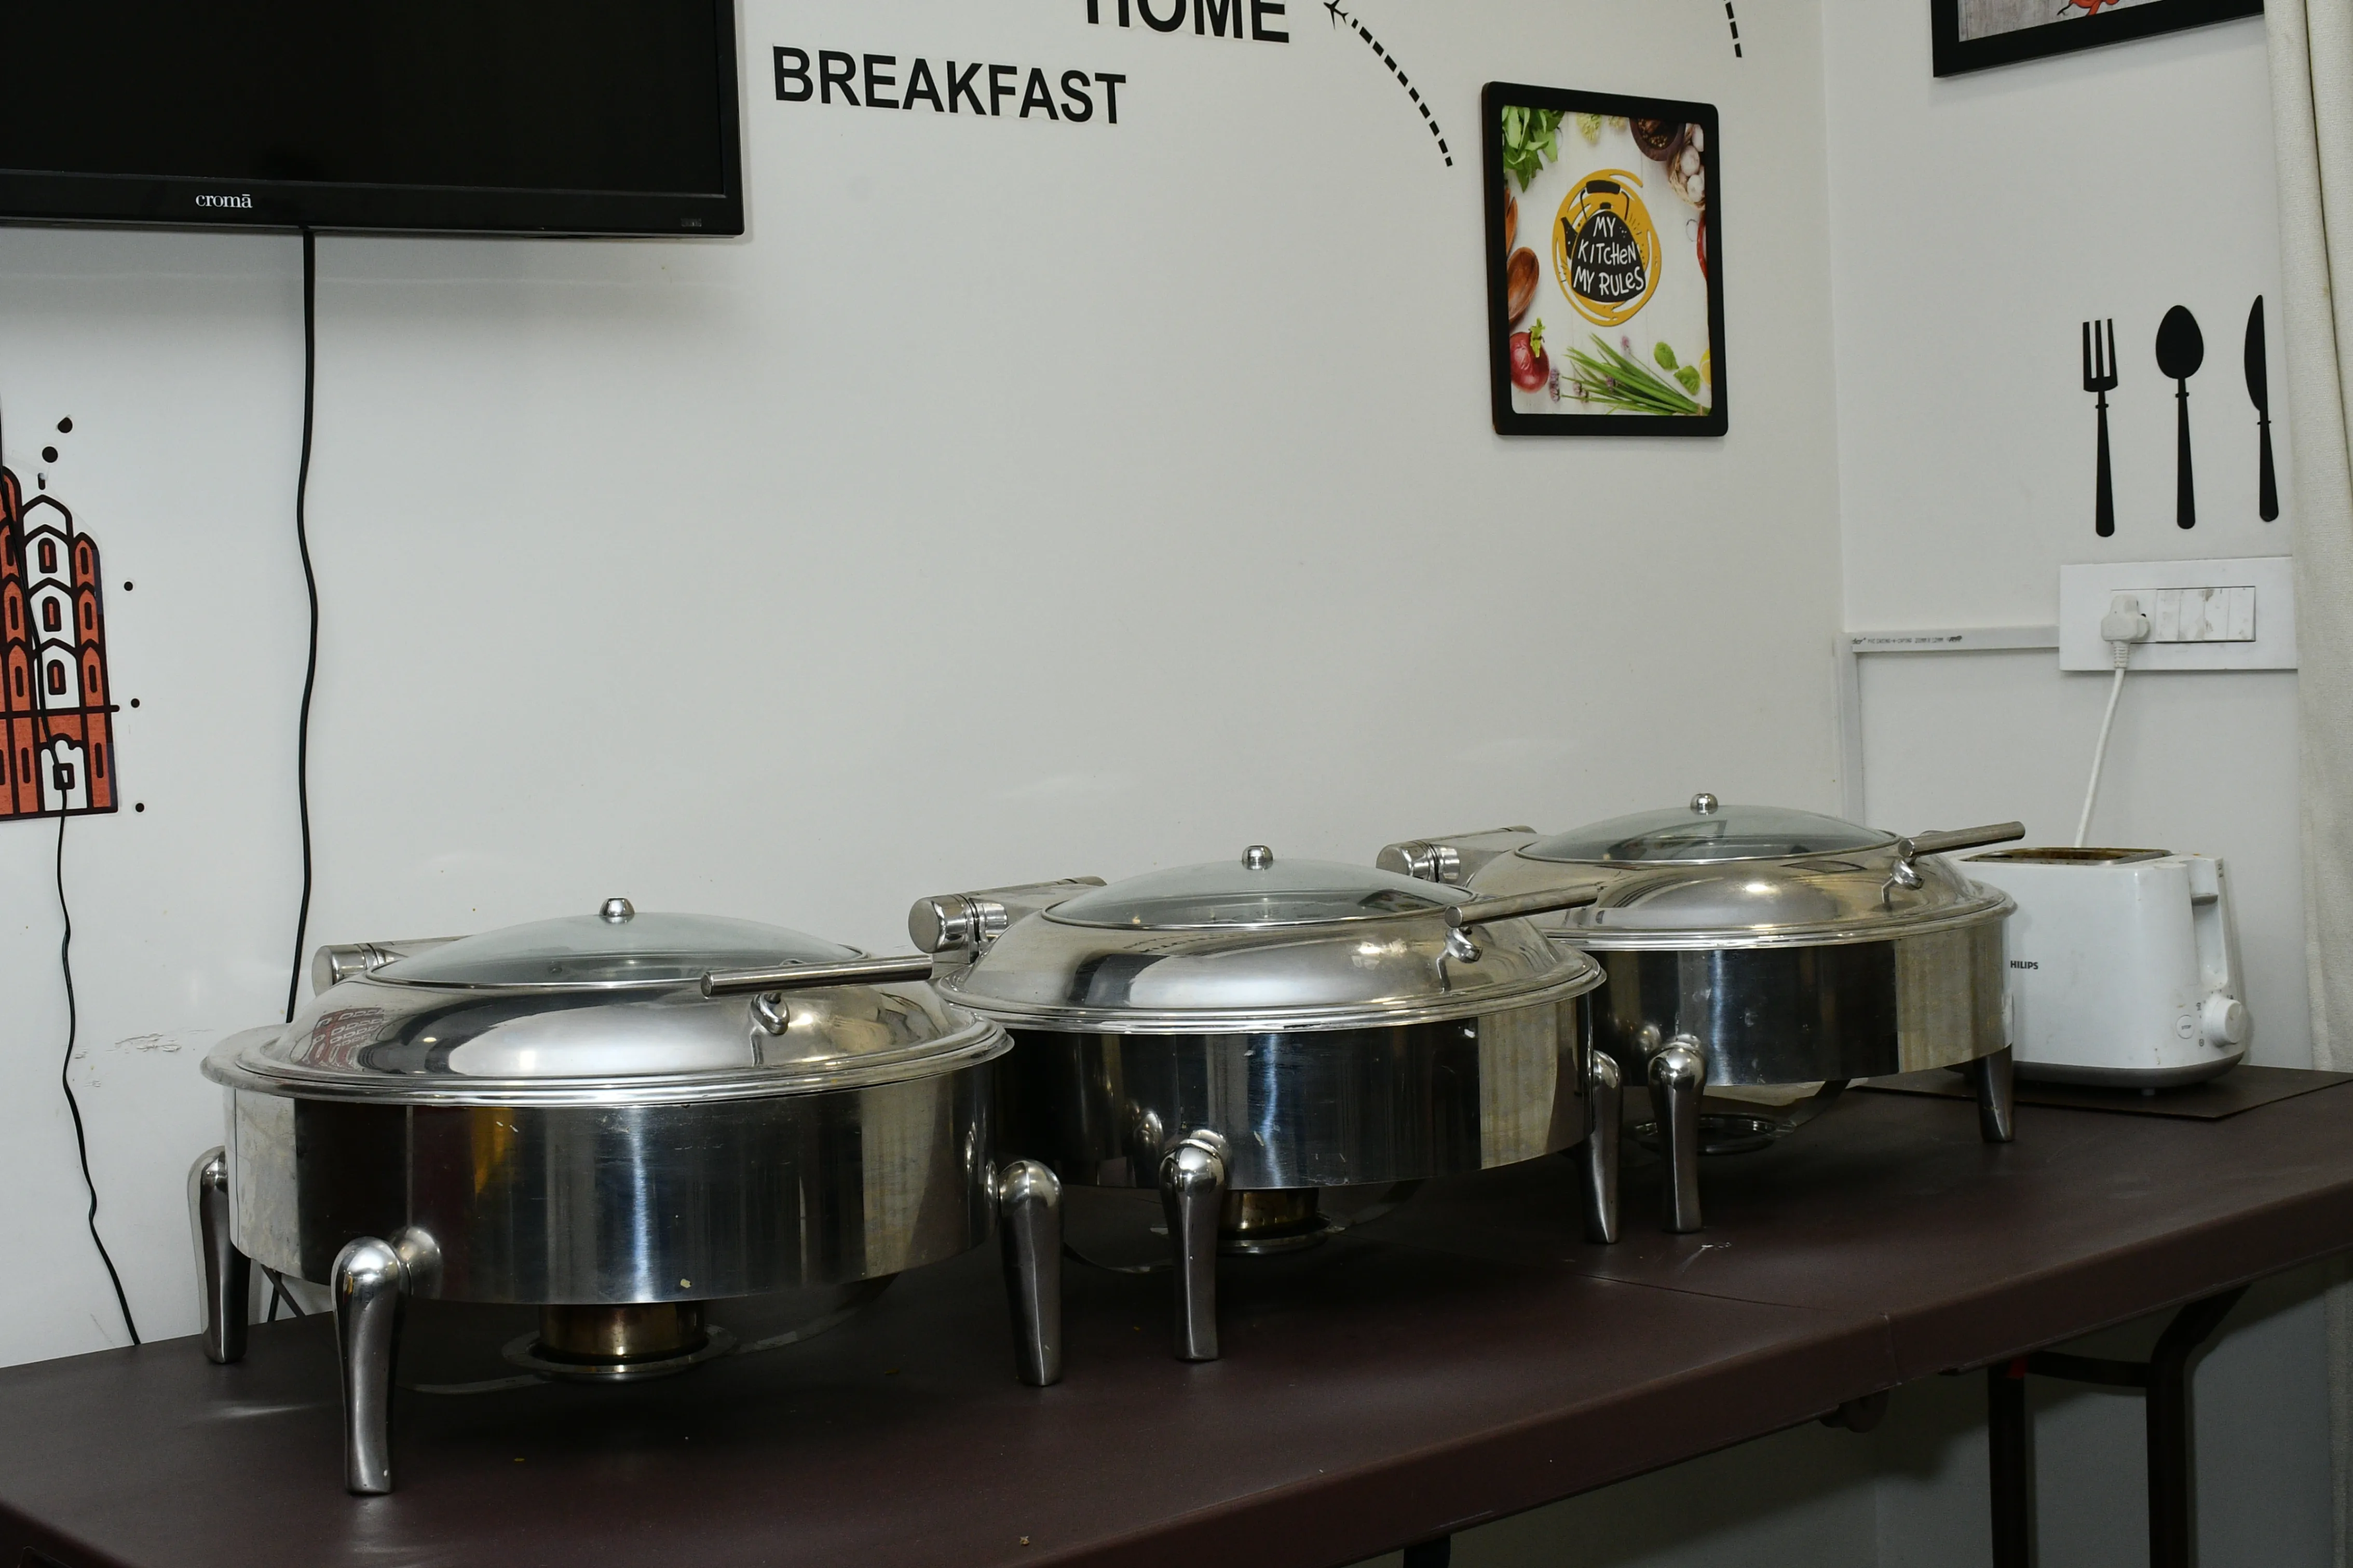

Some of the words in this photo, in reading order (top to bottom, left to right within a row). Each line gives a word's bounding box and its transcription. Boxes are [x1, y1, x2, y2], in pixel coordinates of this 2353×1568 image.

[773, 46, 1126, 124] BREAKFAST
[1593, 216, 1616, 237] MY
[1573, 266, 1595, 293] MY
[2010, 960, 2038, 970] HILIPS
